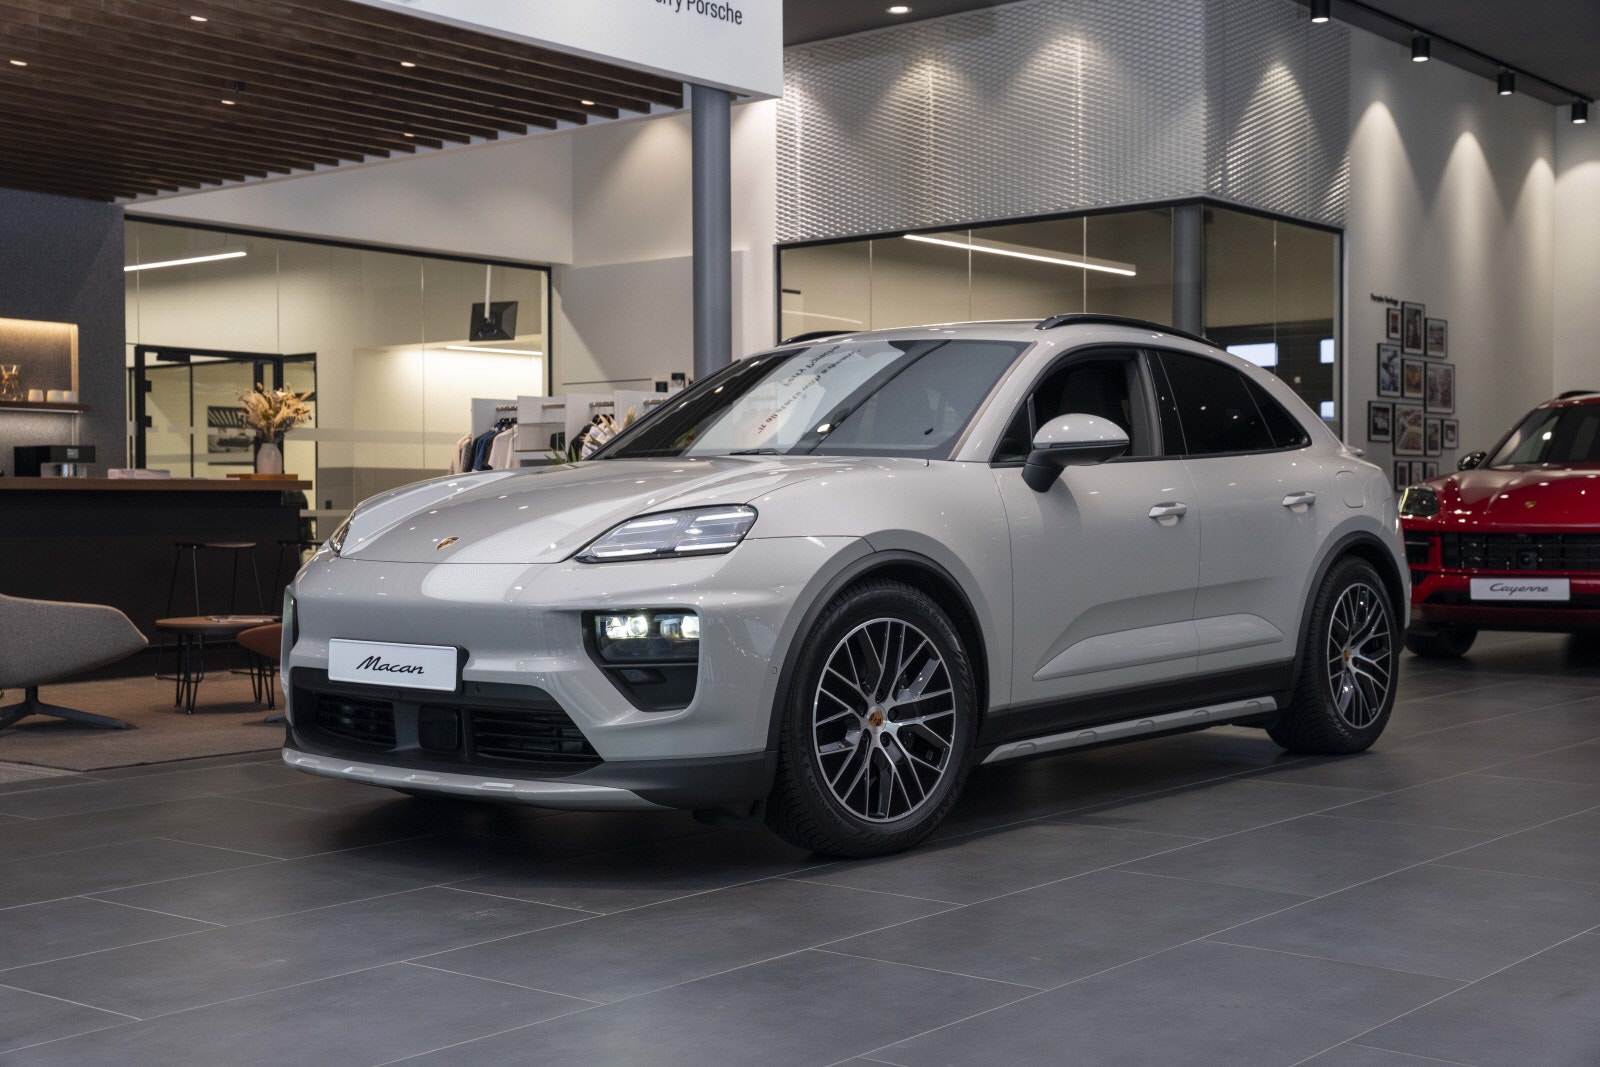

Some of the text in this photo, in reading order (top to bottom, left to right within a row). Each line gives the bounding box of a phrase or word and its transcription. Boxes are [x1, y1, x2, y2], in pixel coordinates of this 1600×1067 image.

[687, 0, 743, 25] Porsche
[1489, 582, 1549, 596] Cayenne
[356, 655, 425, 675] Macan
